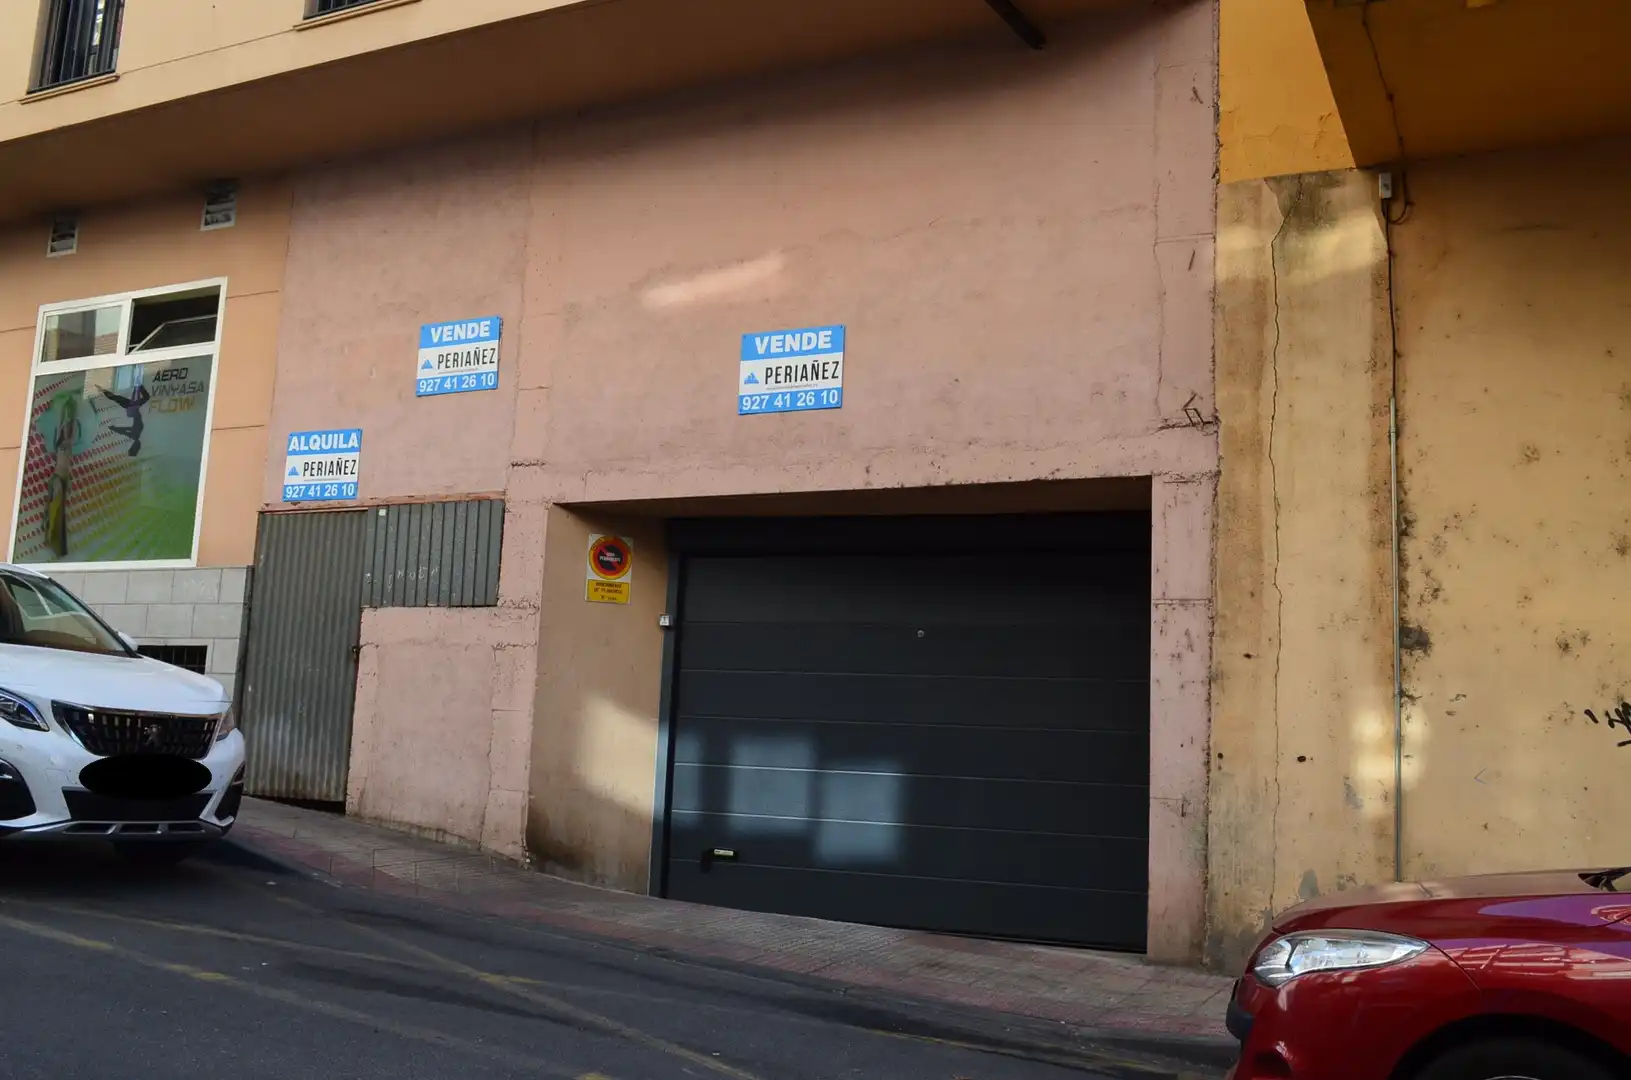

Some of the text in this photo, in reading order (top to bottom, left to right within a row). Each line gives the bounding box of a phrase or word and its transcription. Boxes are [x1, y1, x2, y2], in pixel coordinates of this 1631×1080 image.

[431, 320, 491, 343] VENDE
[754, 330, 832, 355] VENDE
[437, 346, 496, 370] PERIAÑEZ
[152, 367, 189, 383] AERO
[420, 372, 495, 392] 927 41 26 10
[765, 360, 840, 385] PERIAÑEZ
[151, 380, 205, 397] VINYASA
[148, 396, 196, 414] FLOW
[742, 389, 838, 411] 927 41 26 10
[288, 432, 359, 452] ALQUILA
[303, 457, 357, 477] PERIAÑEZ
[286, 483, 355, 498] 927 41 26 10
